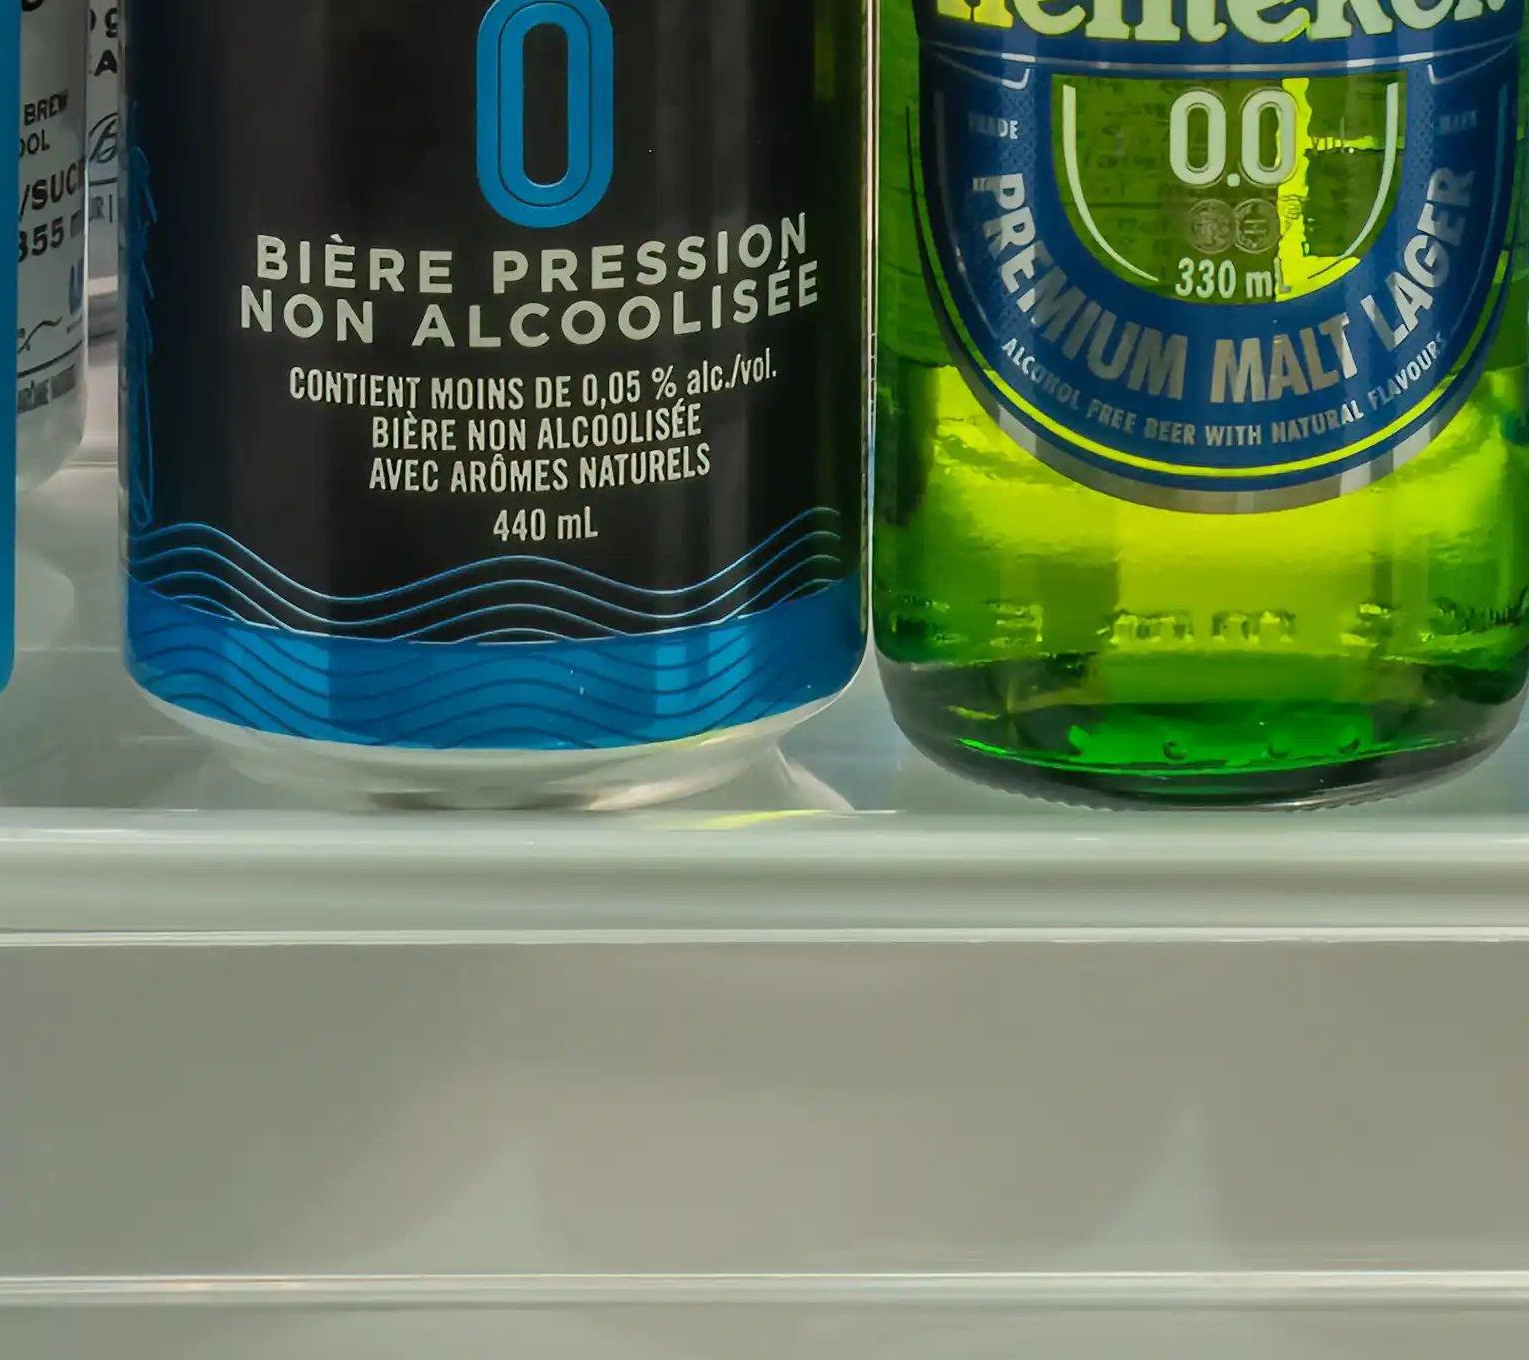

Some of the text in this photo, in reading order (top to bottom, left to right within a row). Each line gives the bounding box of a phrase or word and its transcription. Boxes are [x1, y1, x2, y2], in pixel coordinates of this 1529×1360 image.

[24, 89, 70, 127] BREW
[1169, 87, 1298, 187] 0.0
[256, 211, 808, 295] BIÈRE PRESSION
[1174, 256, 1292, 299] 330 mL
[240, 260, 820, 349] NON ALCOOLISÉE
[972, 166, 1478, 405] PREMIUM MALT LAGER
[289, 347, 778, 412] CONTIENT MOINS DE 0,05 % alc./vol.
[371, 401, 702, 452] BIÈRE NON ALCOOLISÉE
[1085, 398, 1137, 435] FREE
[1144, 416, 1196, 446] BEER
[1205, 424, 1262, 447] WITH
[1271, 399, 1364, 444] NATURAL
[369, 443, 712, 494] AVEC ARÔMES NATURELS
[492, 506, 599, 543] 440 mL
